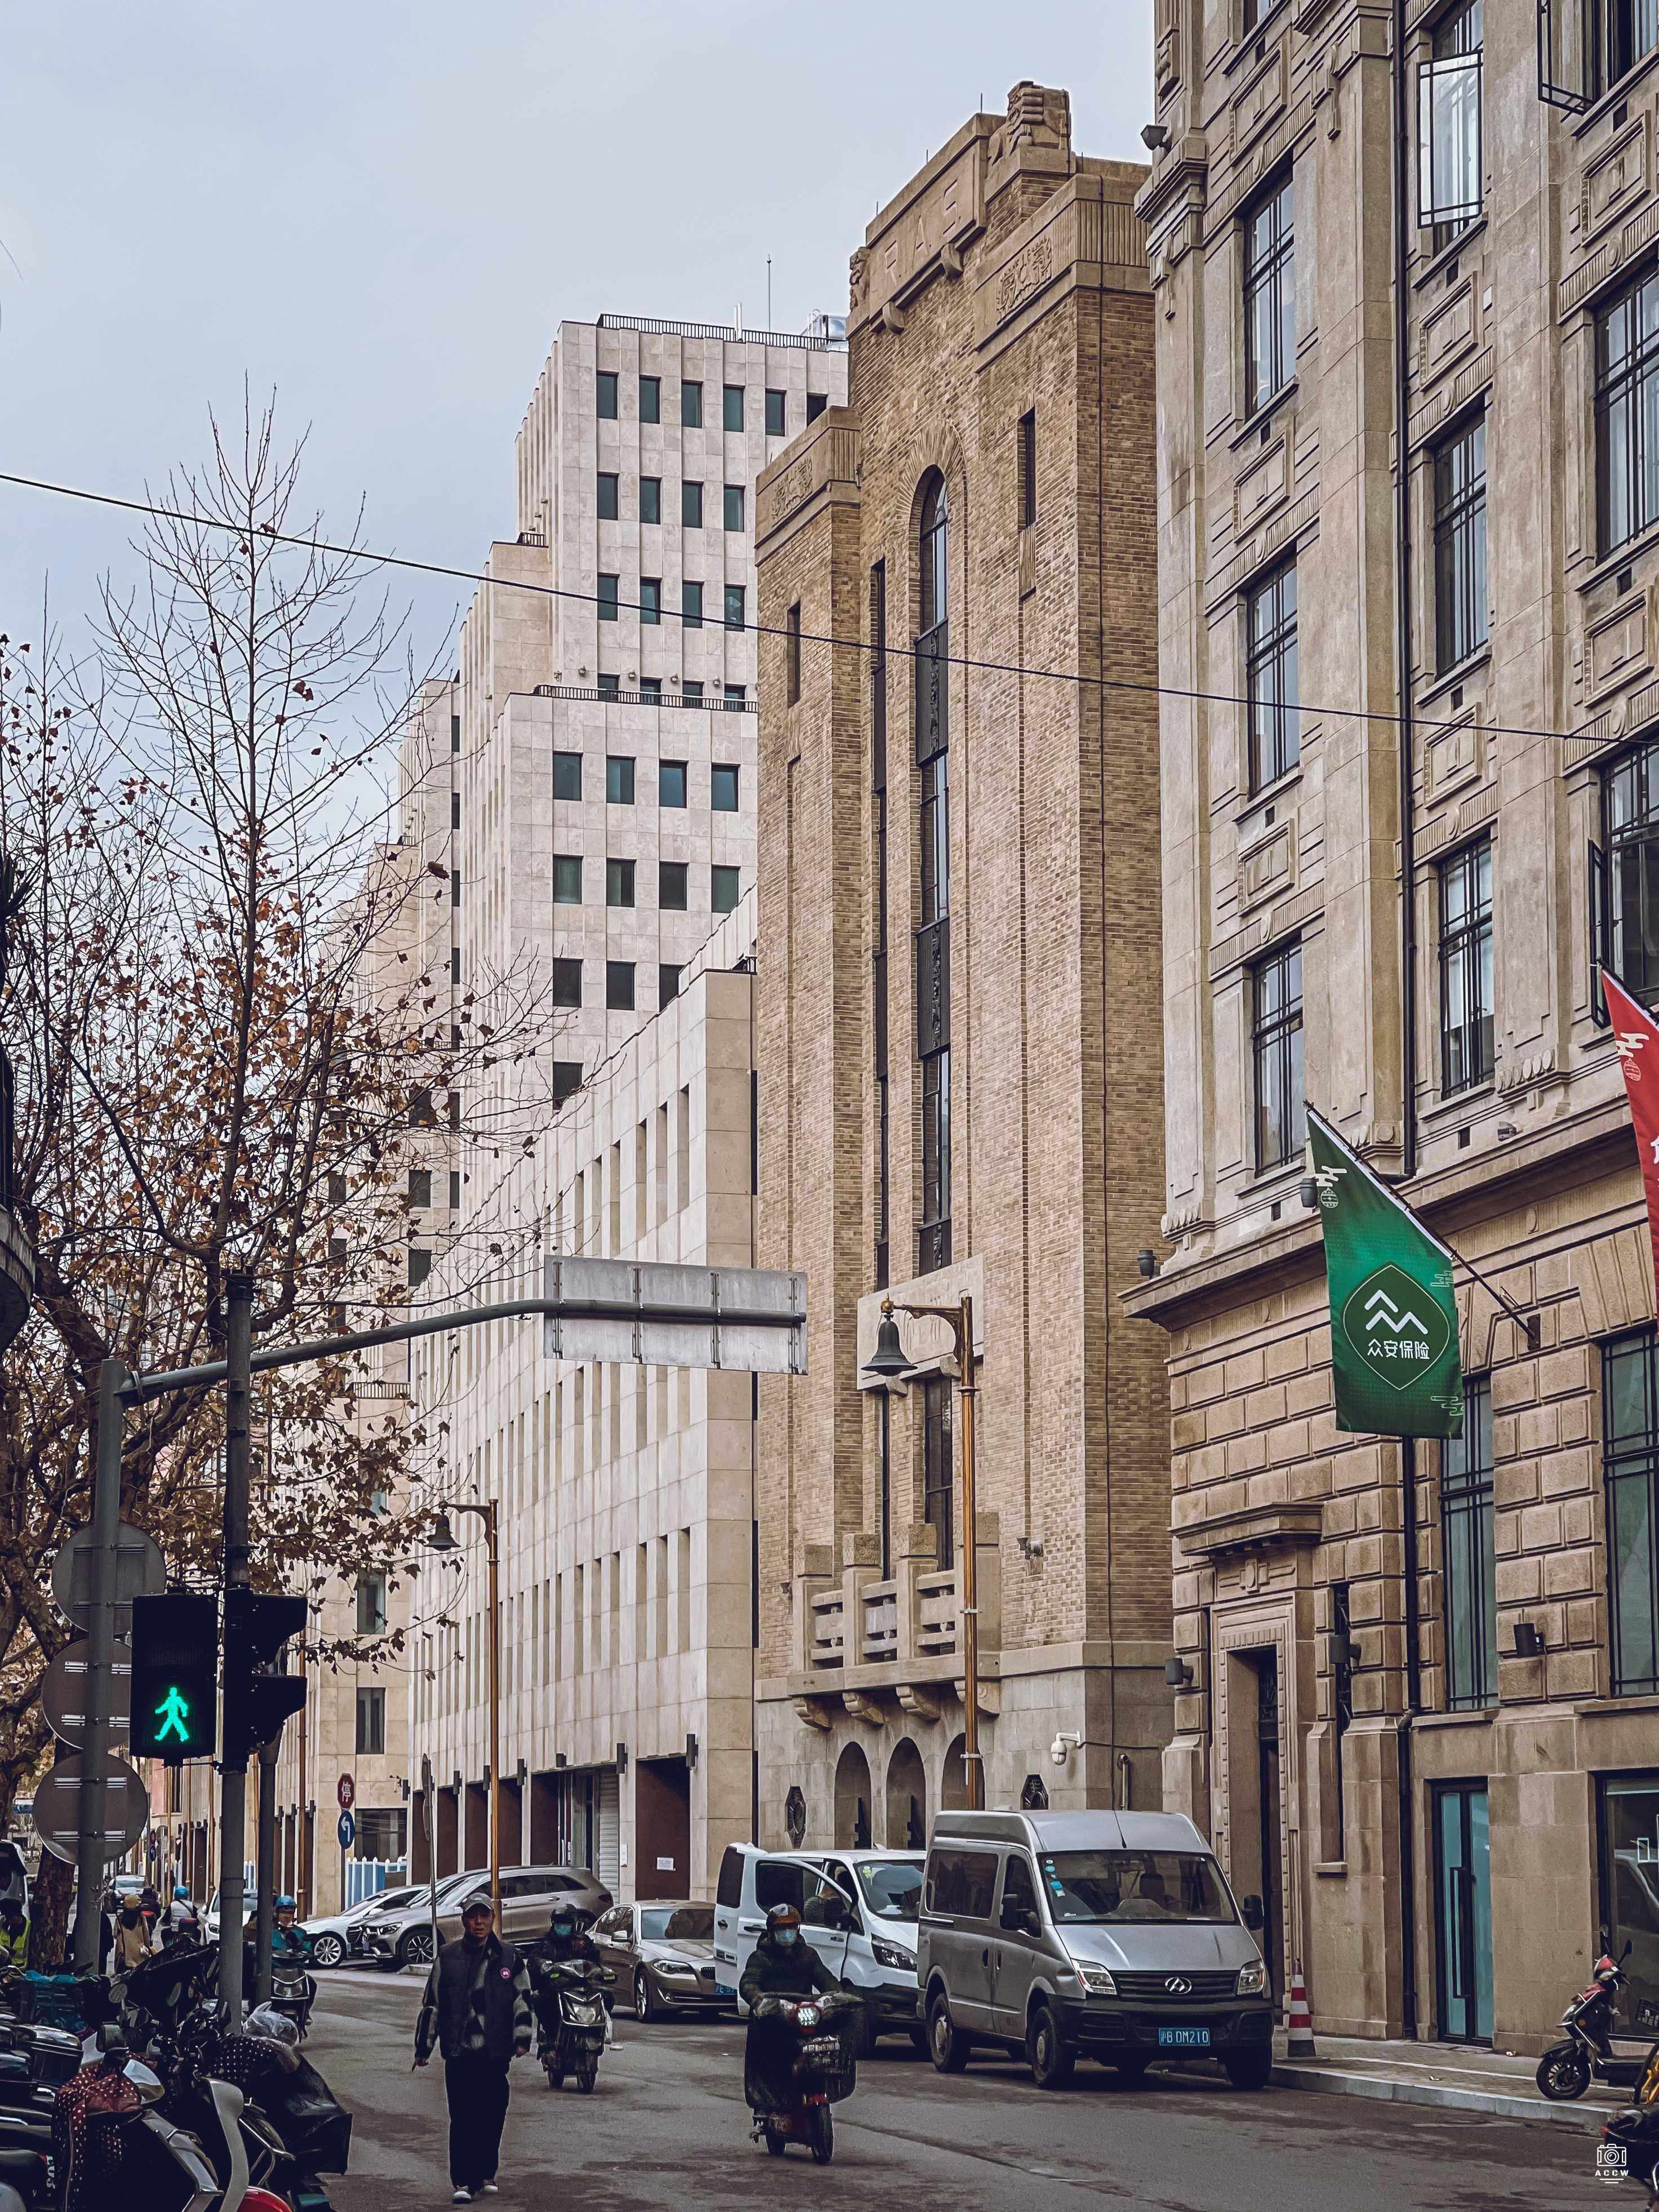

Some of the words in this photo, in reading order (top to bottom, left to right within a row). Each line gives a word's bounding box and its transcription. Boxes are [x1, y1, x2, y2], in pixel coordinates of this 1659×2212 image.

[1367, 1338, 1430, 1359] 众安保险
[341, 1780, 351, 1802] 停
